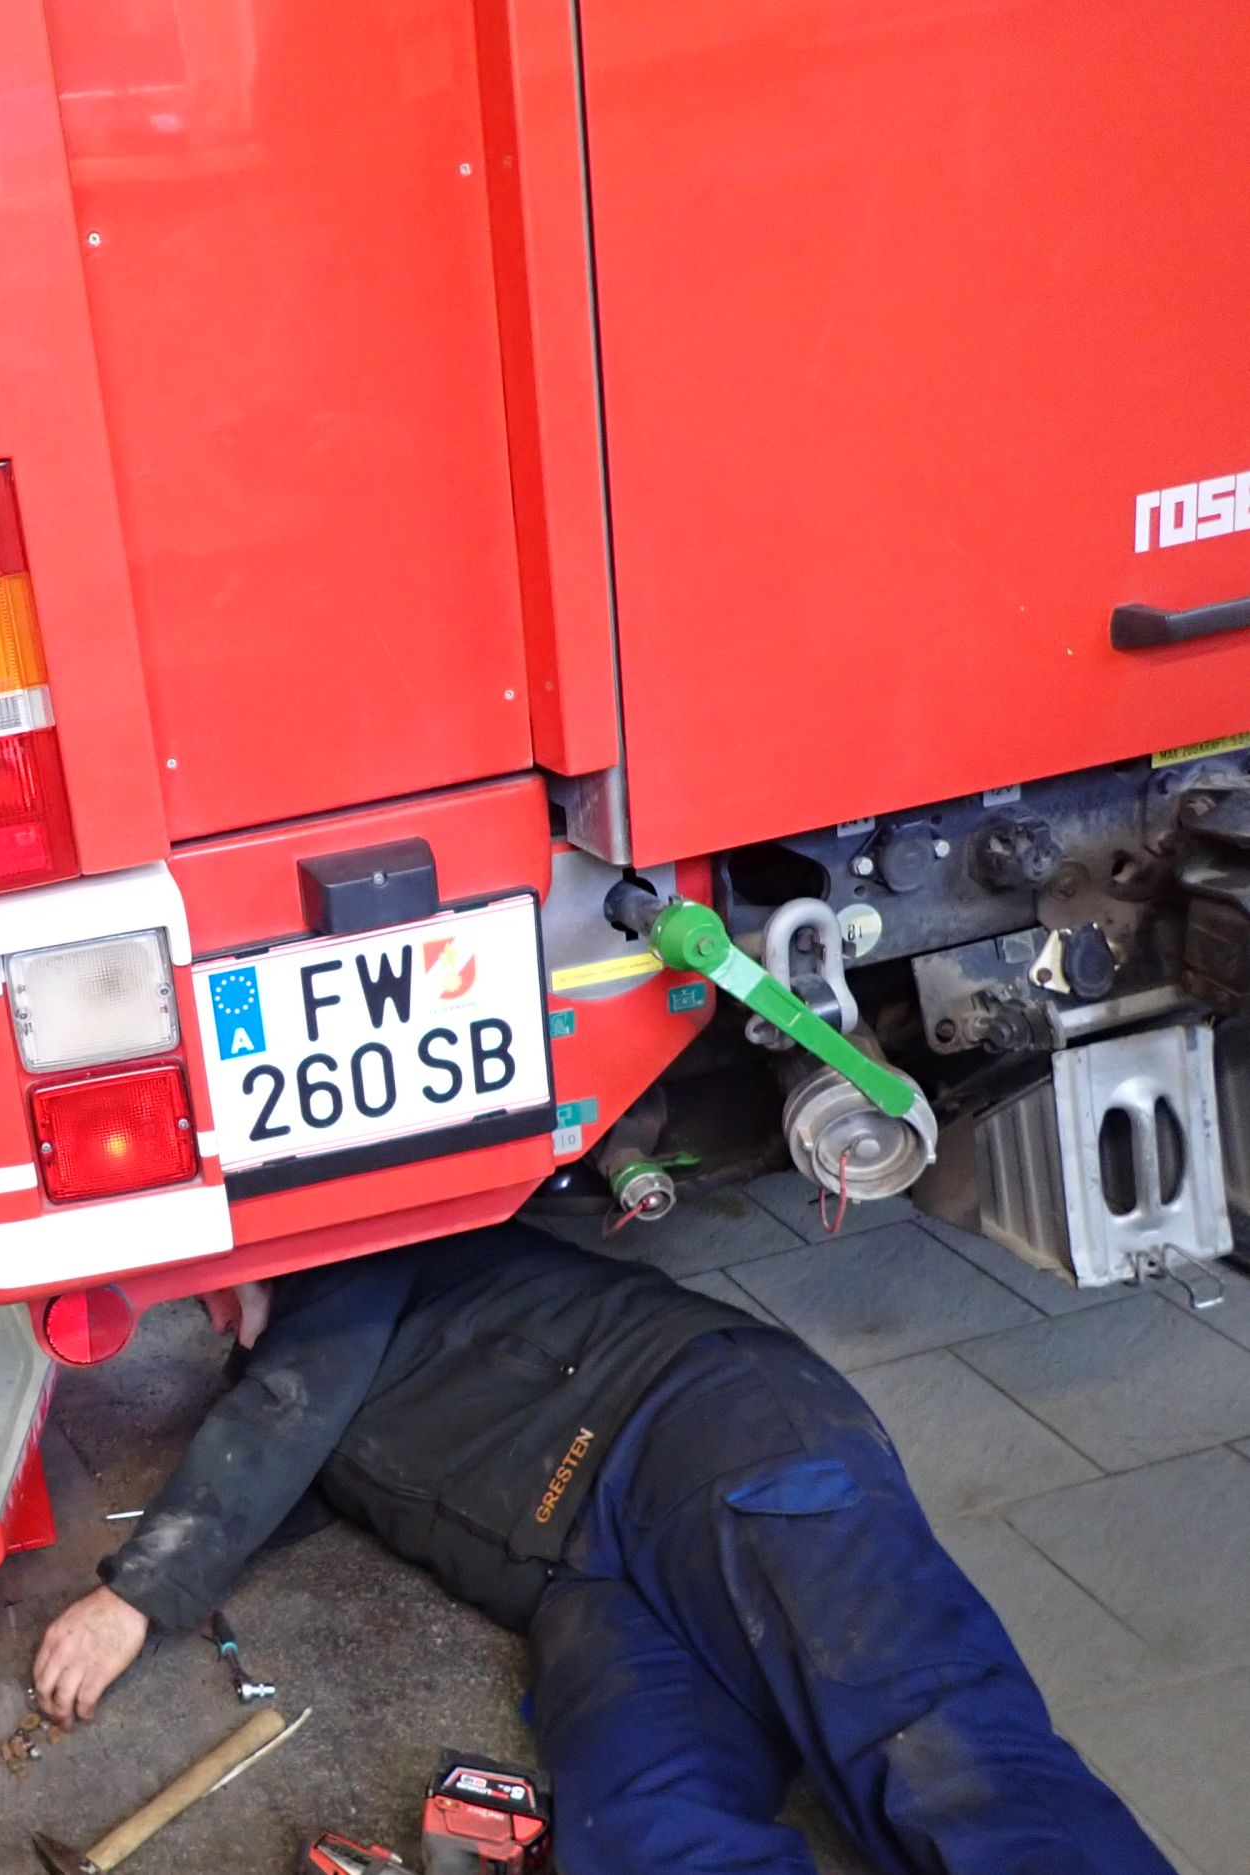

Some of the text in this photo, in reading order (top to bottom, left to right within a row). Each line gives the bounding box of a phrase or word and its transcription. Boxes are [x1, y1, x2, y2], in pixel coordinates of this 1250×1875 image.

[231, 1027, 255, 1055] A
[300, 944, 412, 1042] FW
[242, 1017, 516, 1142] 260 SB
[536, 1427, 594, 1523] GRESTEN
